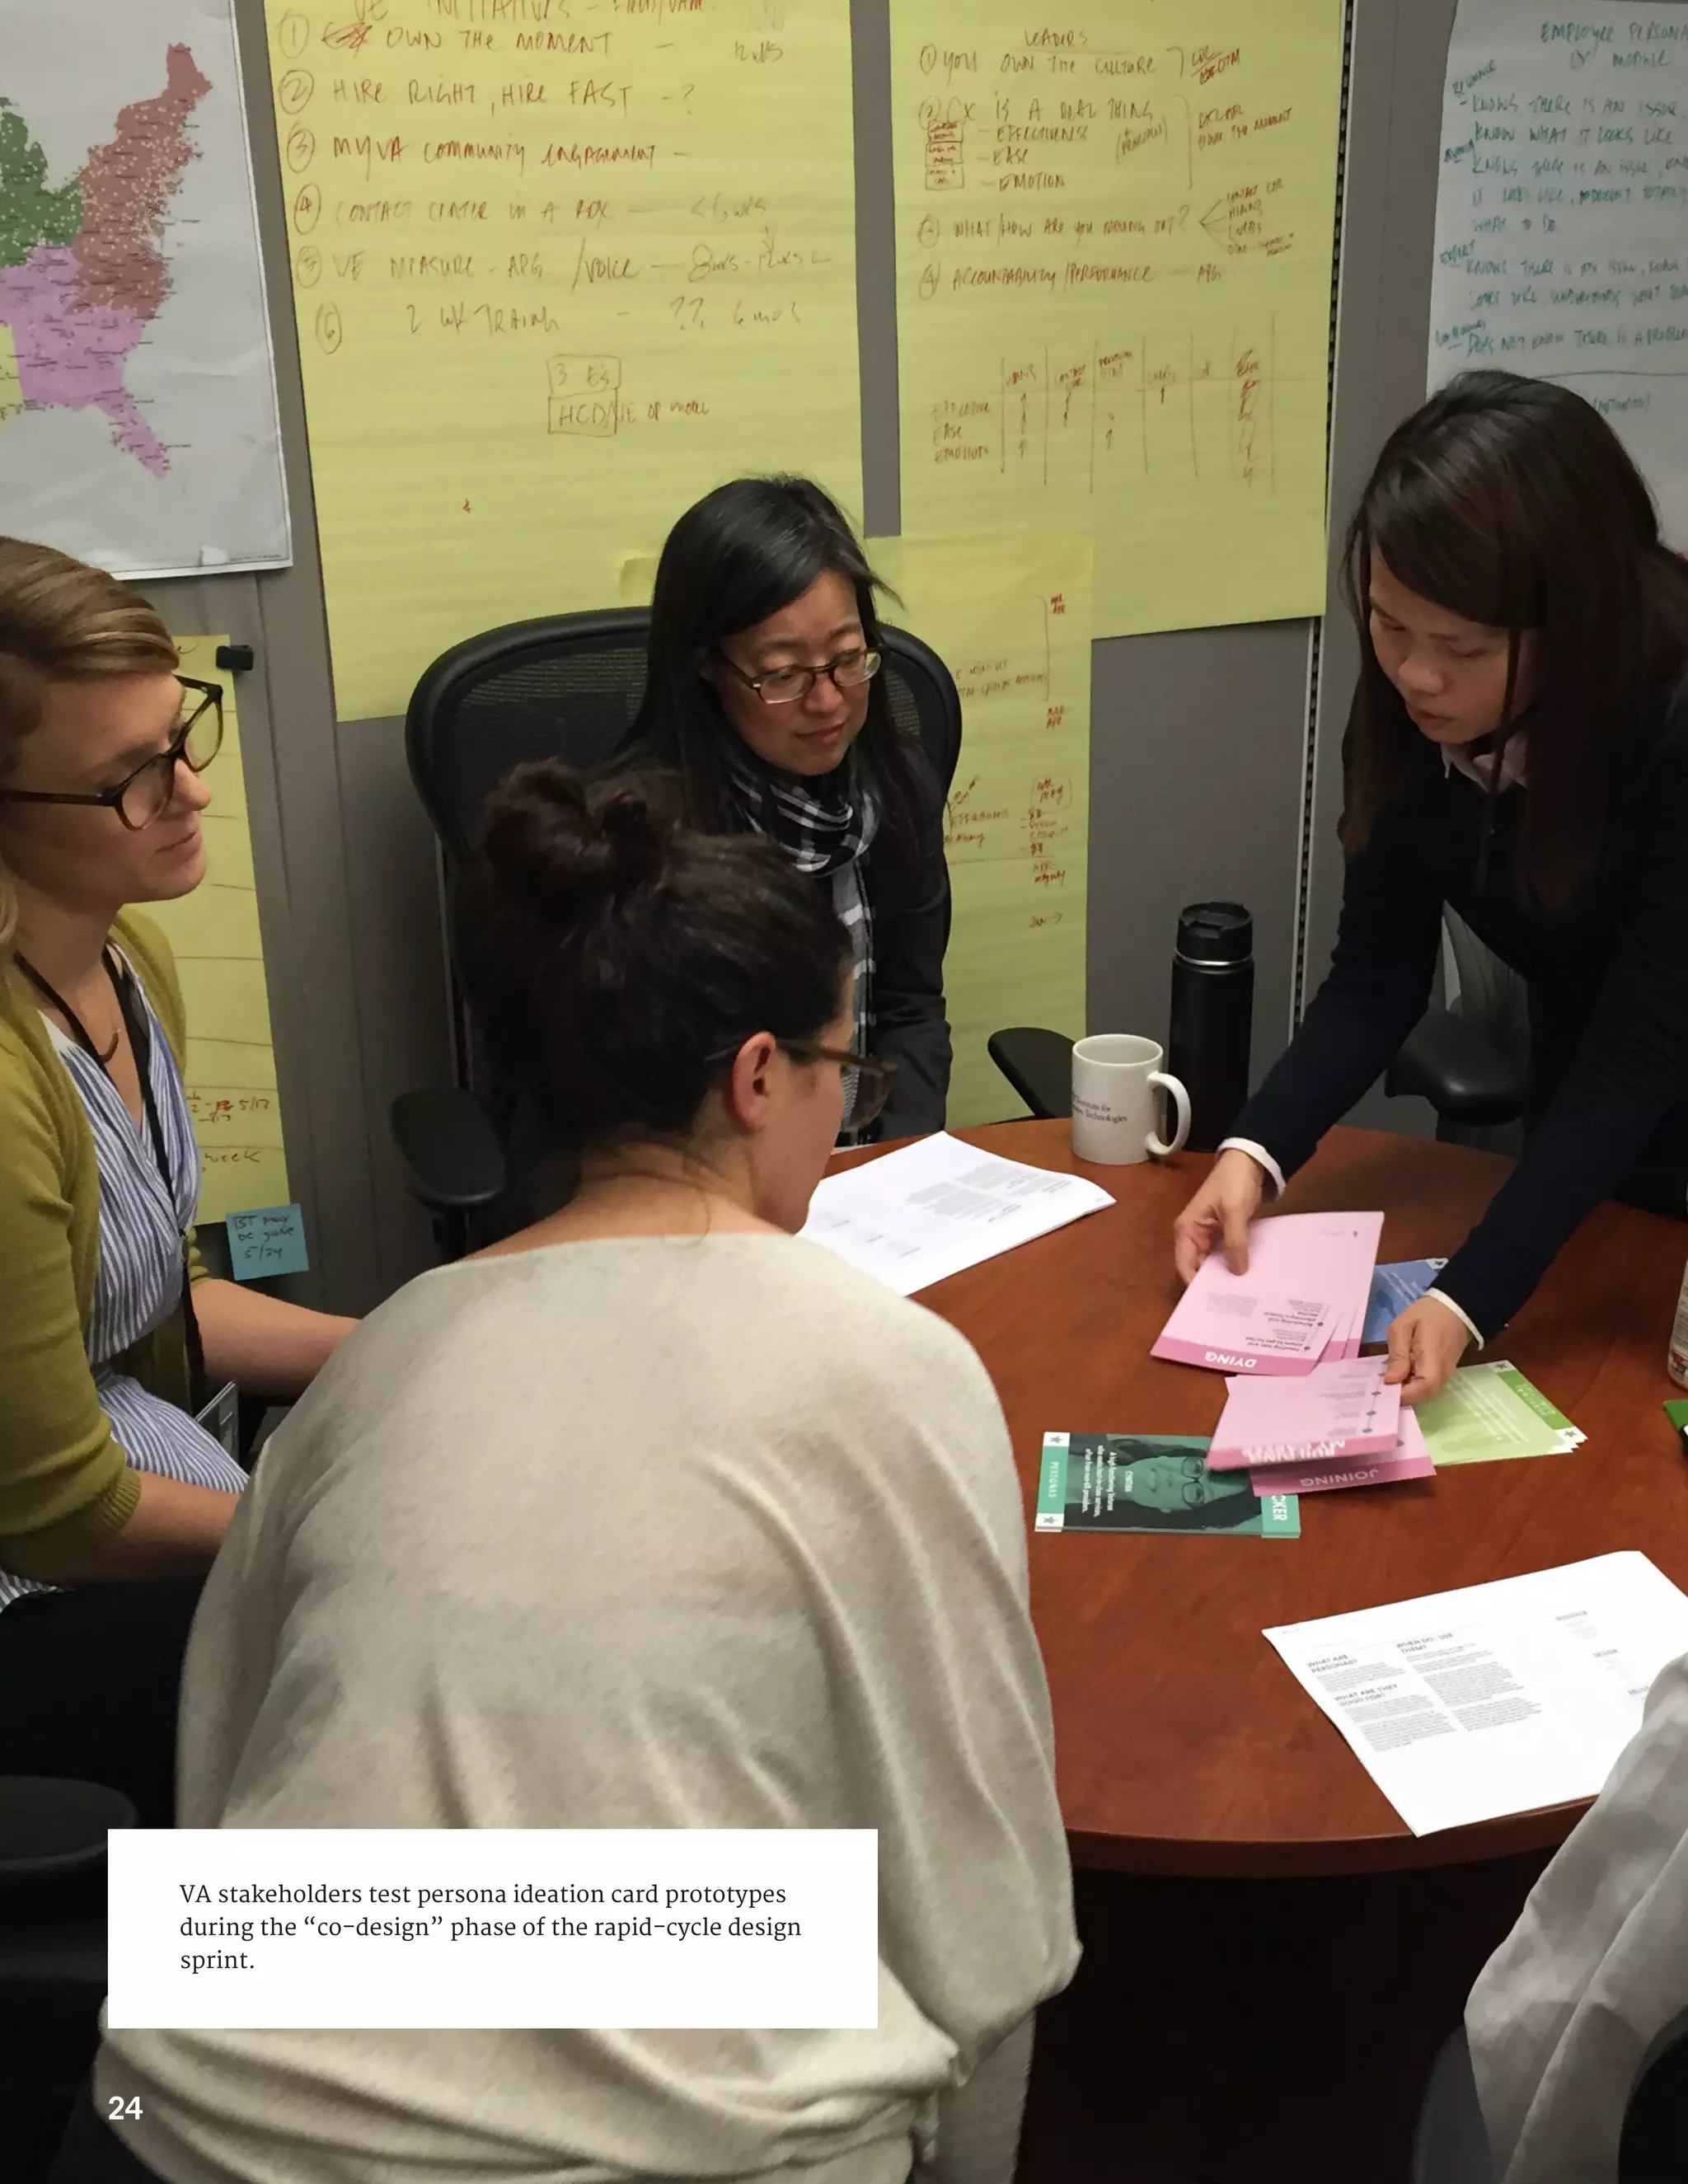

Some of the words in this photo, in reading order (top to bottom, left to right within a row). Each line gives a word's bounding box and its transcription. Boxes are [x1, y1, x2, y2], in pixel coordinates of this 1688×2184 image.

[387, 26, 442, 49] OWN
[458, 30, 497, 52] THE
[516, 30, 612, 54] MOMENT
[1025, 28, 1088, 47] LEADERS
[1095, 56, 1157, 75] CULTURE
[333, 78, 383, 103] HIRE
[570, 79, 633, 115] FAST
[999, 171, 1066, 192] EMOTION
[1085, 1109, 1128, 1125] Technologies
[1204, 1351, 1258, 1369] DYING
[1048, 1462, 1059, 1498] PERSONAS
[1299, 1469, 1379, 1487] JOINING
